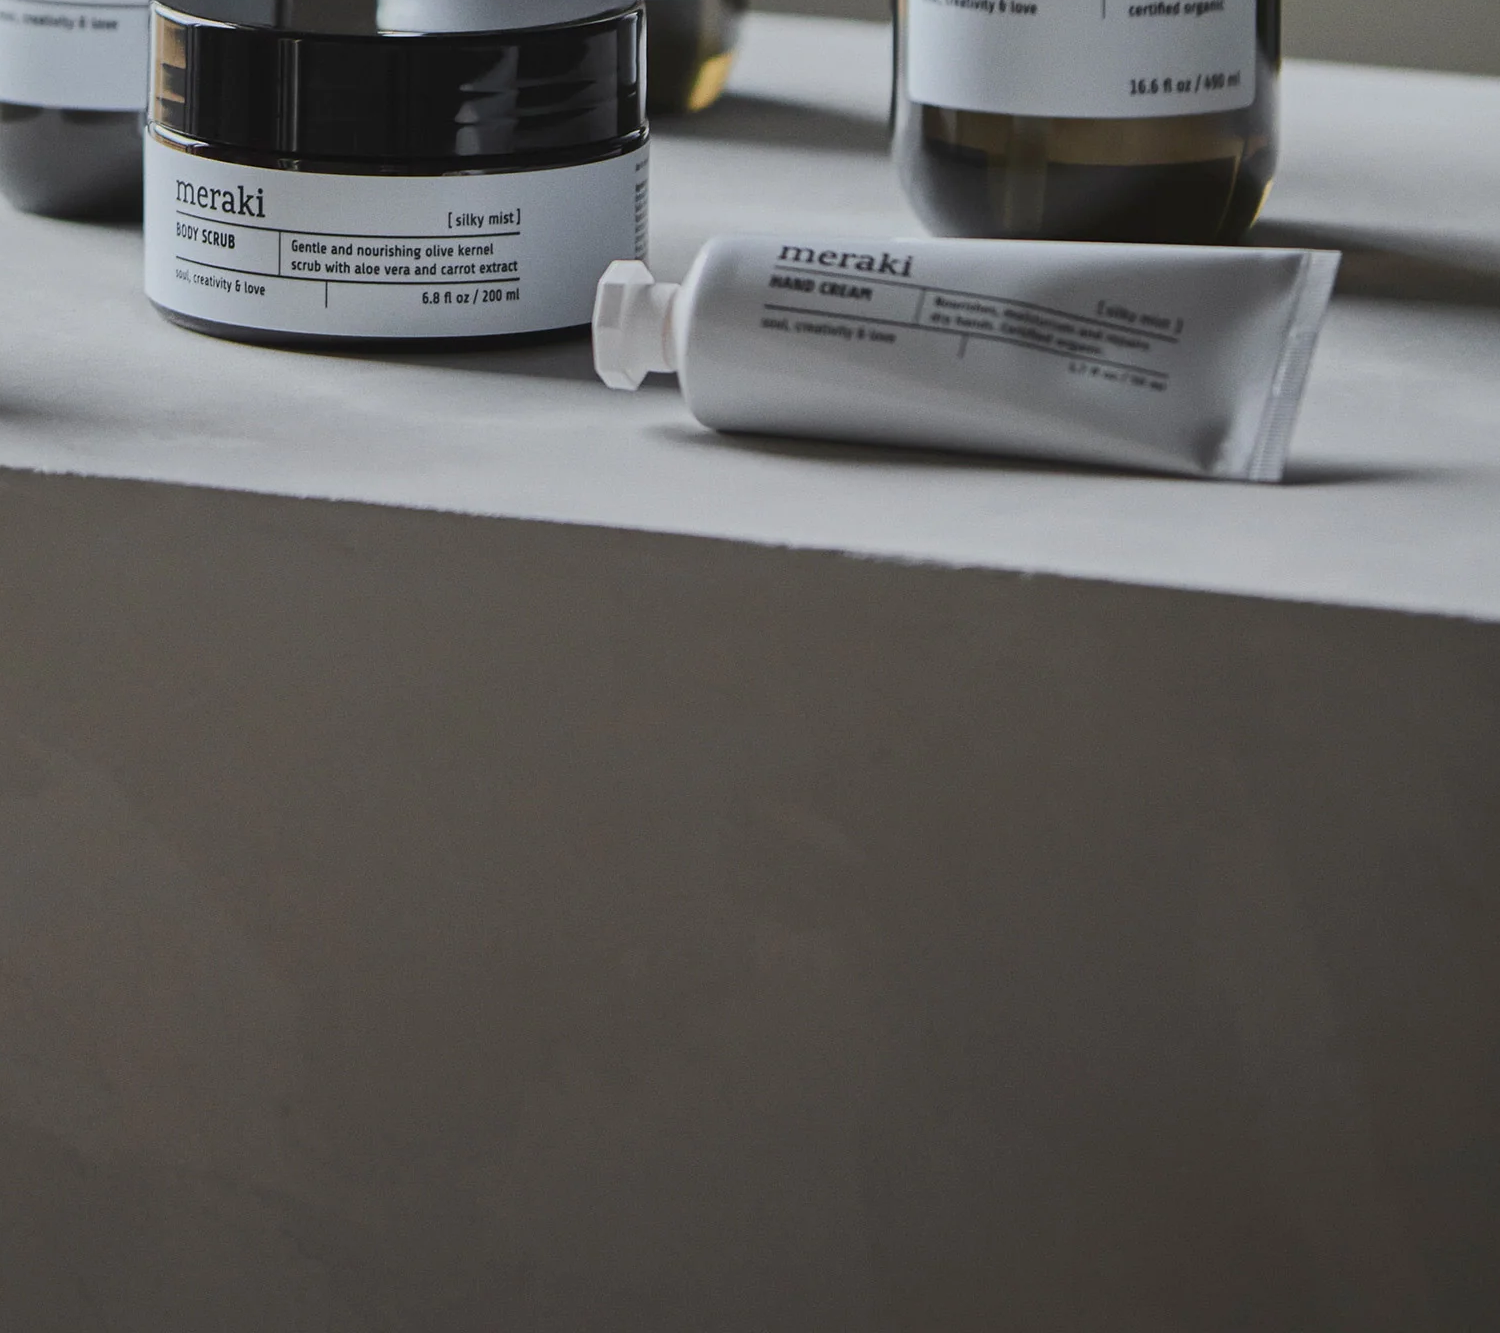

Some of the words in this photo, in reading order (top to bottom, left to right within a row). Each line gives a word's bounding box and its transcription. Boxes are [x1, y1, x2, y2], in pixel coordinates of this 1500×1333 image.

[1011, 0, 1037, 14] love
[1129, 2, 1180, 17] certified
[1131, 79, 1158, 95] 16.6
[1163, 77, 1172, 93] fl
[1177, 80, 1191, 93] oz
[1195, 73, 1201, 93] /
[176, 179, 266, 218] meraki
[456, 212, 484, 228] silky
[489, 209, 514, 224] mist
[176, 221, 198, 241] BODY
[202, 229, 235, 249] SCRUB
[291, 239, 327, 254] Gentle
[331, 243, 353, 255] and
[357, 244, 421, 259] nourishing
[425, 244, 454, 257] olive
[458, 243, 494, 256] kernel
[291, 259, 321, 272] scrub
[325, 260, 350, 274] with
[355, 262, 380, 275] aloe
[384, 264, 410, 275] vera
[414, 263, 437, 275] and
[441, 263, 476, 275] carrot
[479, 260, 518, 274] extract
[778, 245, 913, 277] meraki
[193, 273, 232, 293] creativity
[235, 279, 241, 292] &
[244, 281, 266, 296] love
[422, 292, 440, 304] 6.8
[444, 291, 452, 304] fl
[456, 292, 470, 303] oz
[482, 290, 502, 302] 200
[506, 288, 520, 301] ml
